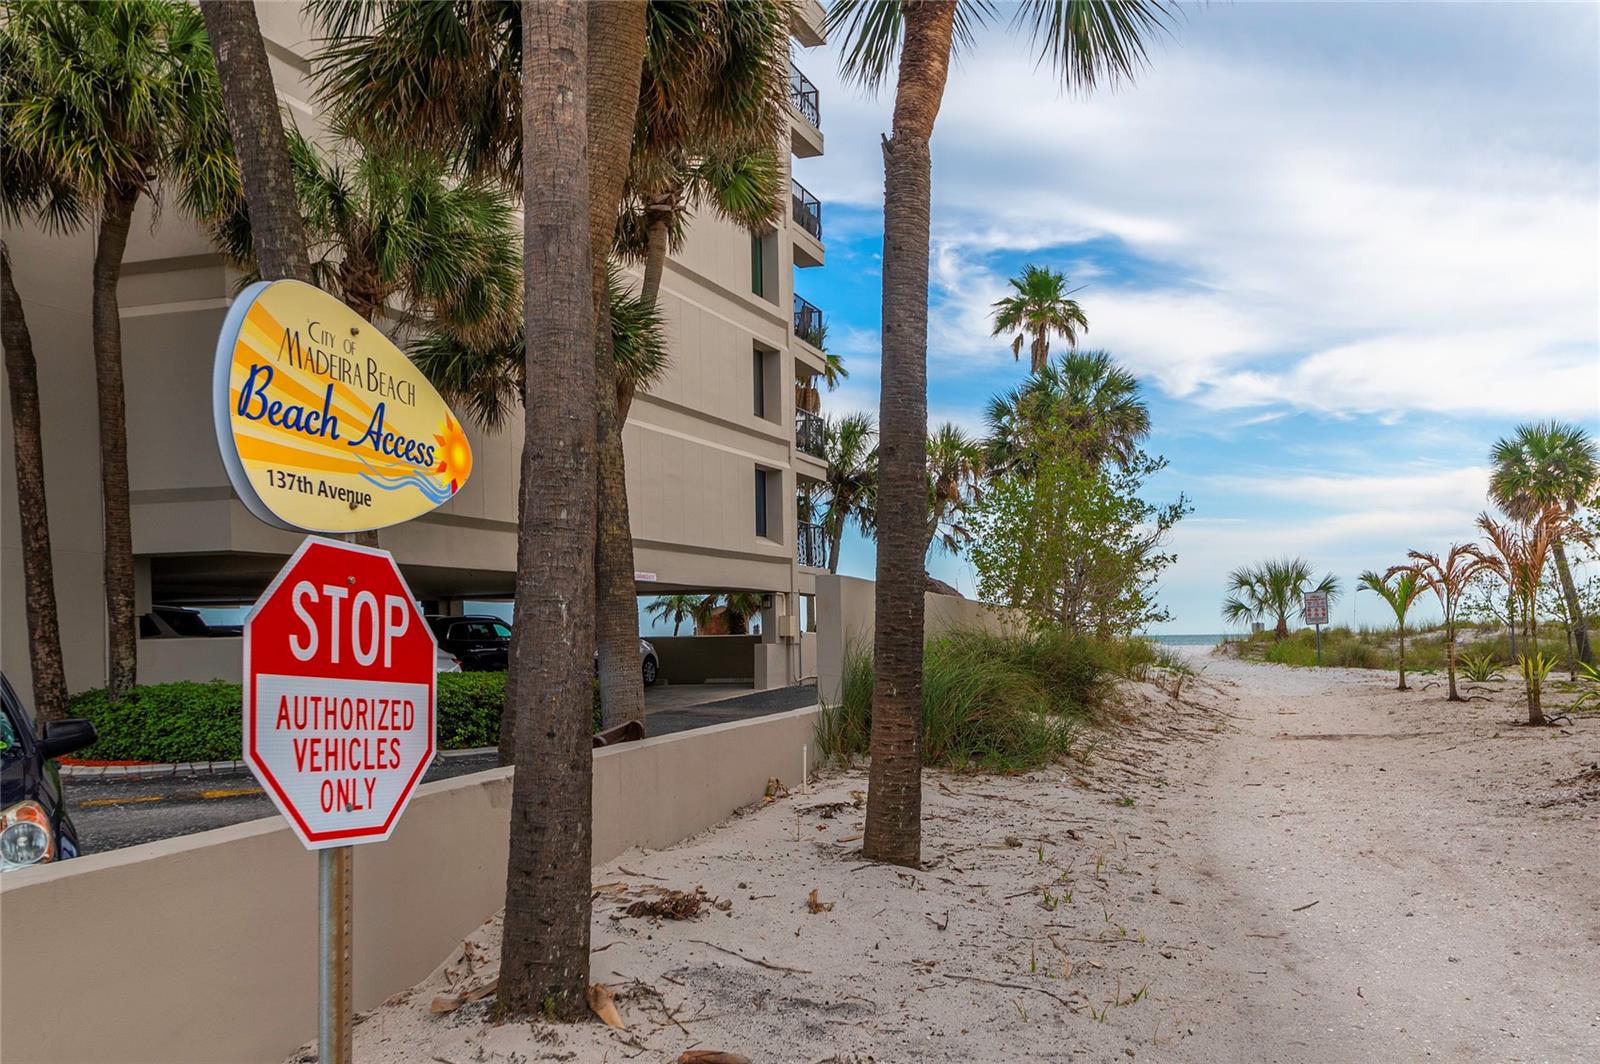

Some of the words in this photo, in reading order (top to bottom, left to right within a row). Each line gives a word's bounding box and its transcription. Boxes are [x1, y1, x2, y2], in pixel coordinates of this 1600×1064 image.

[308, 321, 336, 348] CITY
[277, 327, 363, 386] MADEIRA
[367, 357, 416, 407] BEACH
[237, 364, 340, 440] Beach
[348, 402, 435, 467] Access
[266, 469, 313, 495] 137th
[317, 480, 372, 508] Avenue
[289, 580, 410, 668] STOP
[276, 695, 415, 731] AUTHORIZED
[293, 738, 401, 773] VEHICLES
[320, 777, 377, 813] ONLY
